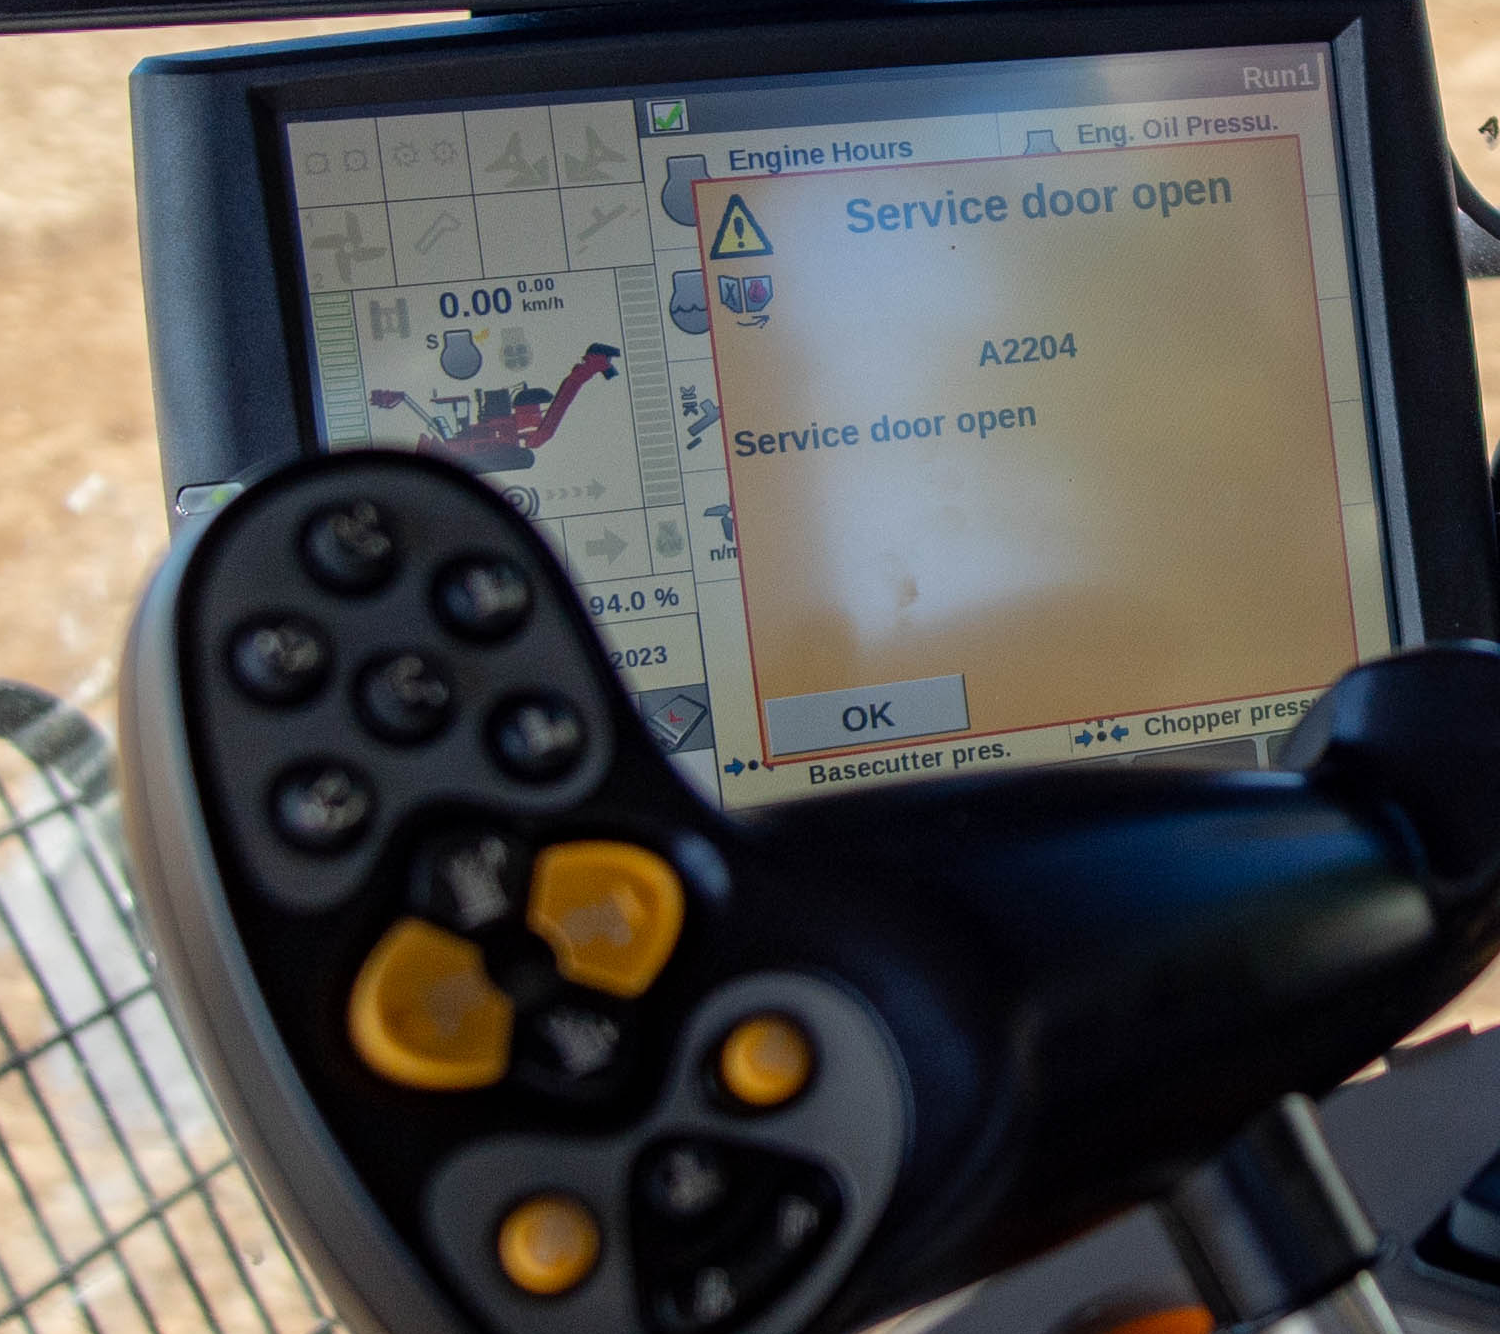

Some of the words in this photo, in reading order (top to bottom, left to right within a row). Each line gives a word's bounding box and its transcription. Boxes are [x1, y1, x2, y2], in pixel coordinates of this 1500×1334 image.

[1242, 62, 1315, 89] Run1
[1077, 123, 1134, 148] Eng.
[1143, 117, 1178, 140] Oil
[1186, 114, 1279, 137] Pressu.
[729, 146, 826, 175] Engine
[832, 140, 913, 164] Hours
[846, 189, 1008, 233] Service
[1022, 182, 1118, 218] door
[1132, 175, 1232, 218] open
[517, 277, 555, 293] 0.00
[439, 286, 513, 319] 0.00
[522, 296, 565, 313] km/h
[979, 333, 1078, 367] A2204
[734, 422, 859, 458] Service
[870, 414, 946, 444] door
[957, 404, 1037, 439] open
[589, 590, 646, 616] 94.0
[654, 586, 680, 608] %
[610, 645, 668, 668] 2023
[842, 701, 896, 732] OK
[1144, 707, 1242, 736] Chopper
[809, 749, 944, 785] Basecutter
[952, 743, 1011, 769] pres.
